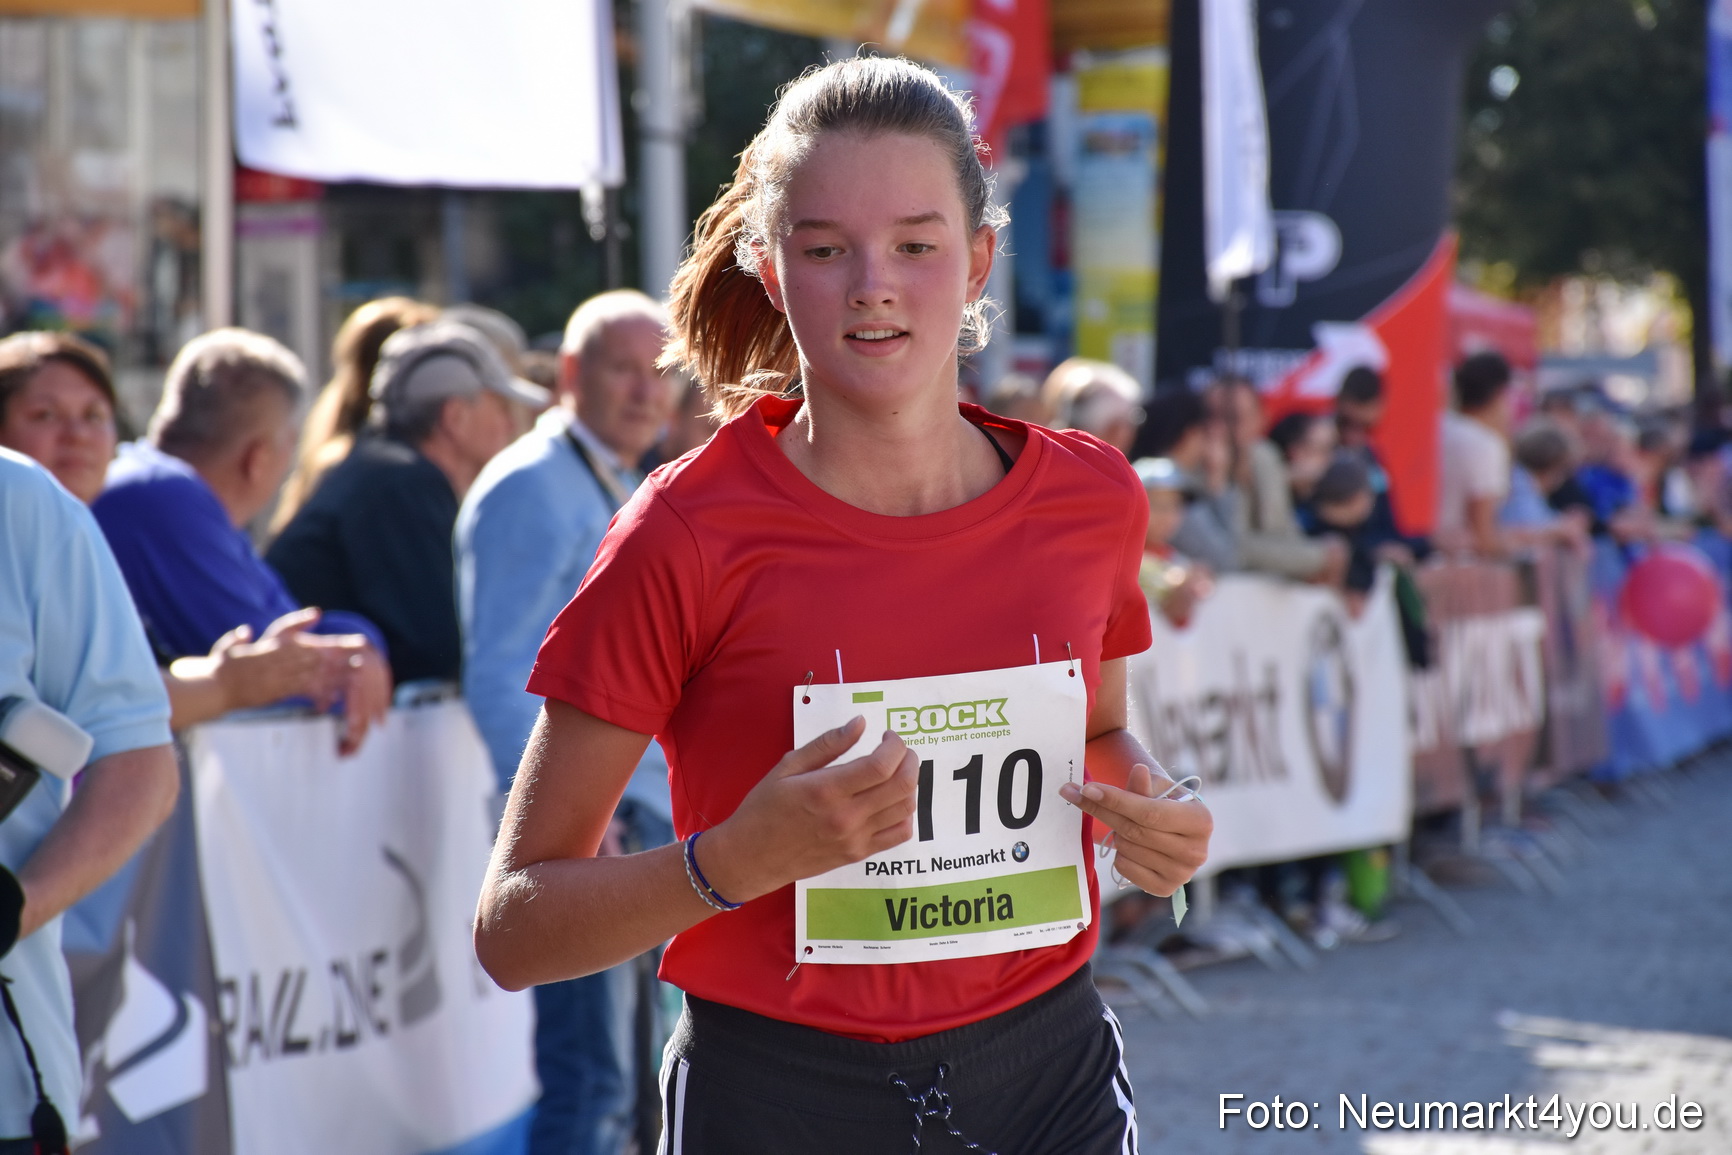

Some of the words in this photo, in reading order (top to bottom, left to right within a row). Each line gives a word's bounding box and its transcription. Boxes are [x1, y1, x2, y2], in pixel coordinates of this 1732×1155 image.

[887, 698, 1010, 735] BOCK
[928, 735, 939, 746] by
[941, 732, 968, 743] smart
[970, 729, 1011, 740] concepts
[917, 748, 1043, 842] 110
[865, 859, 927, 876] PARTL
[931, 848, 1006, 873] Neumarkt
[885, 887, 1014, 932] Victoria
